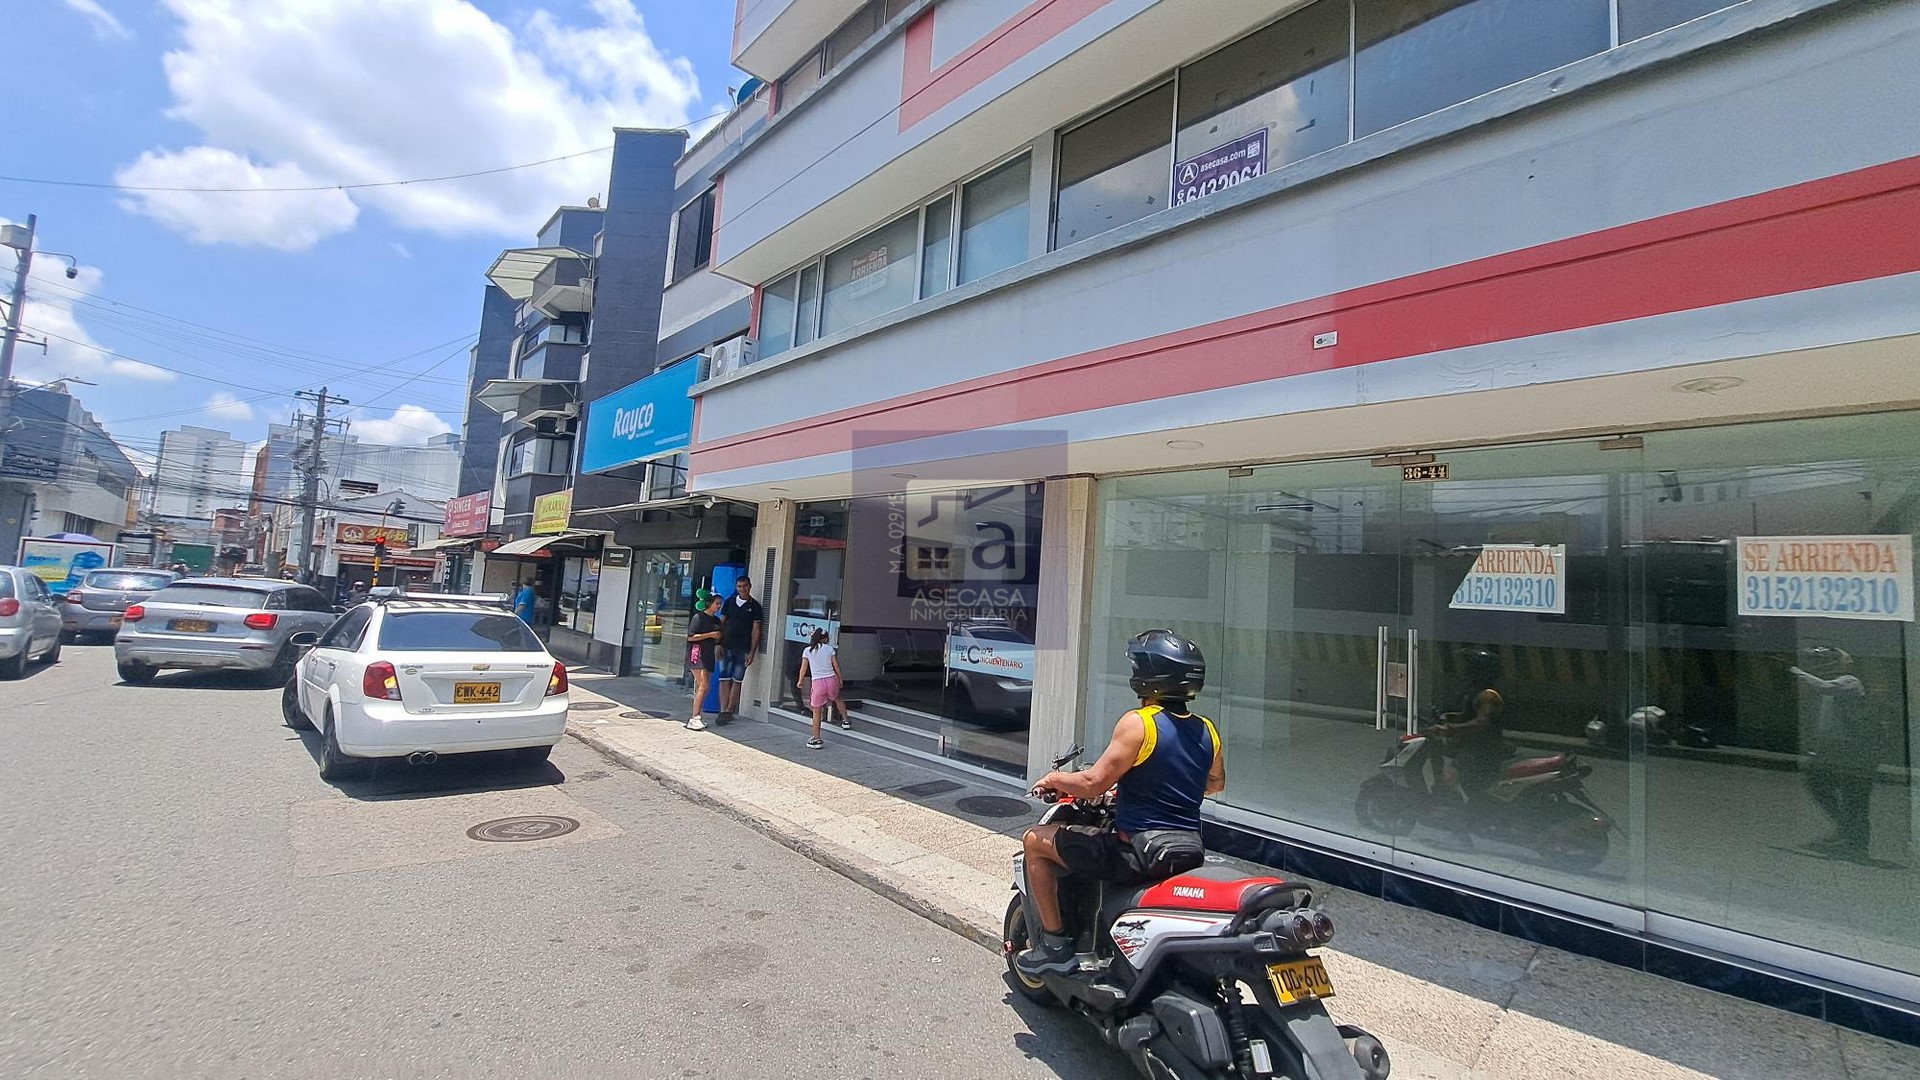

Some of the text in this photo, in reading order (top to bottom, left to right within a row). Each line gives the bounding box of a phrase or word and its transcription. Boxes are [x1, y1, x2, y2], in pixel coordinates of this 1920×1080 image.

[1200, 149, 1246, 172] asecasa.com
[612, 402, 654, 440] Rayco
[1404, 466, 1446, 479] 36-44
[1475, 550, 1556, 575] ARRIENDA
[1743, 542, 1897, 573] SE ARRIENDA
[1455, 576, 1555, 608] 3152132310
[1746, 575, 1899, 615] 3152132310
[1172, 885, 1205, 899] YAMAHA
